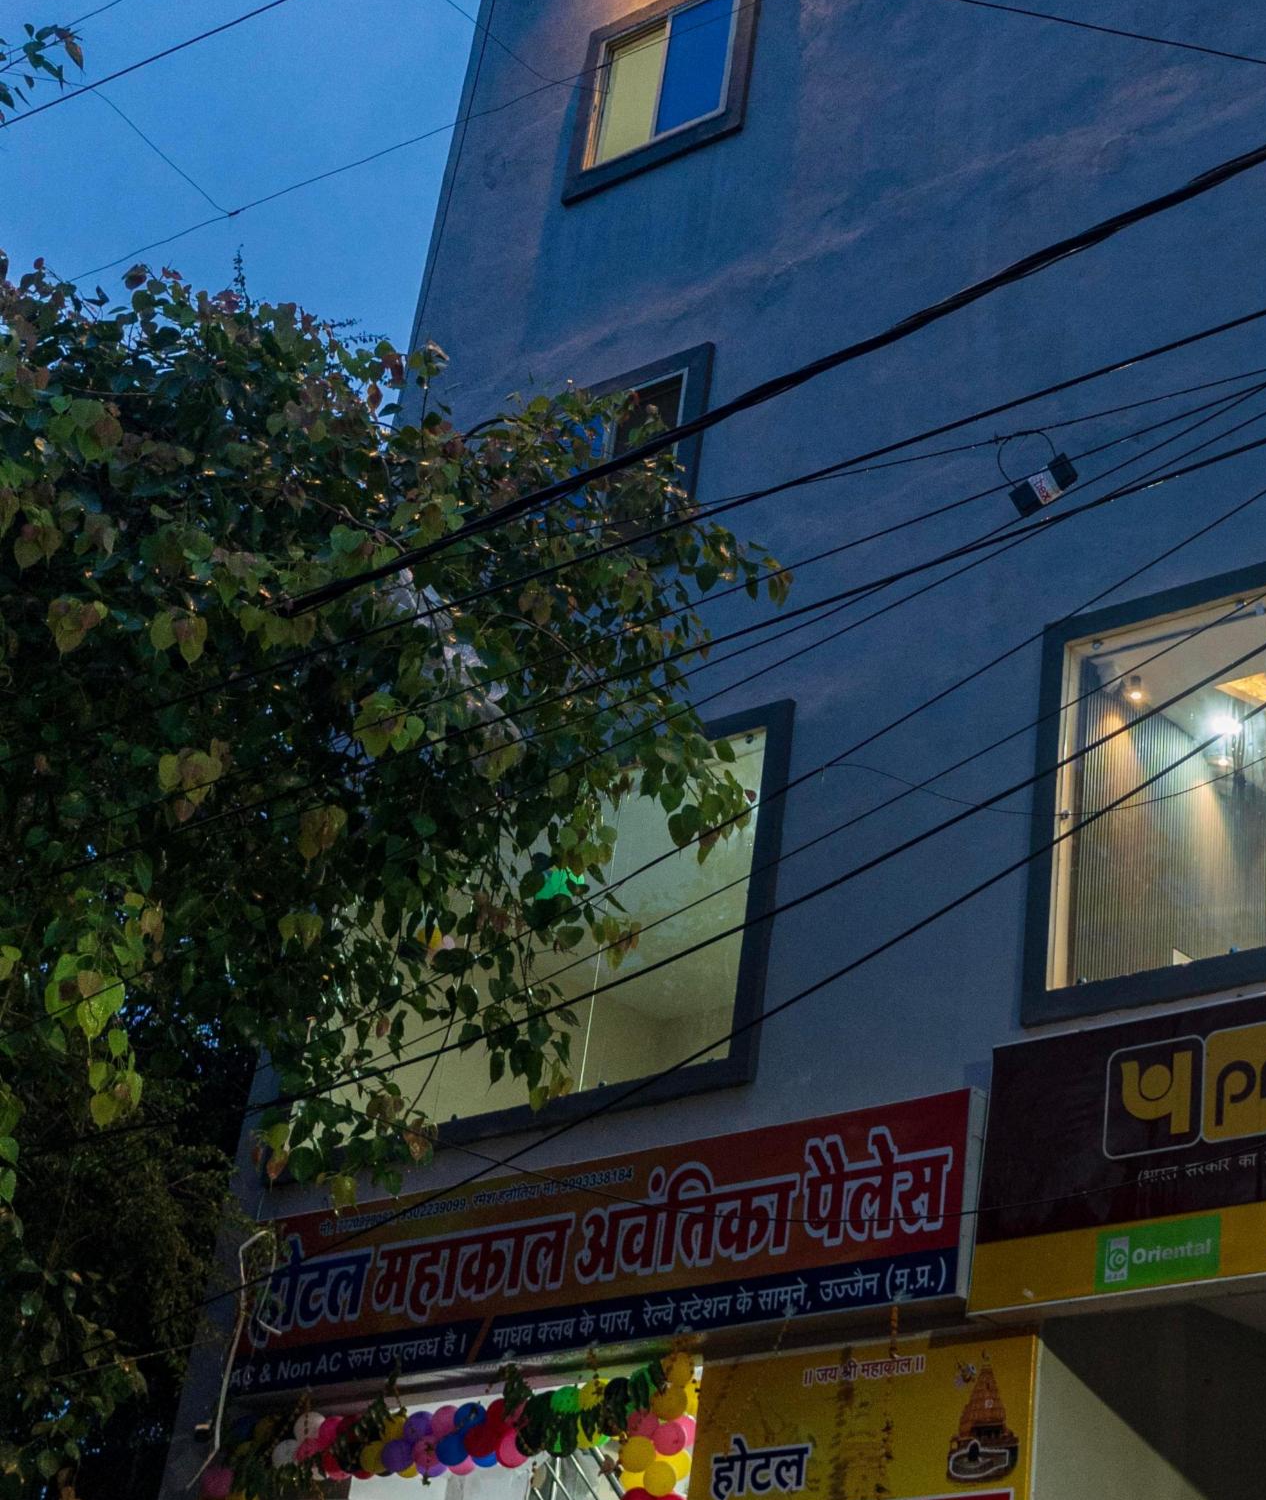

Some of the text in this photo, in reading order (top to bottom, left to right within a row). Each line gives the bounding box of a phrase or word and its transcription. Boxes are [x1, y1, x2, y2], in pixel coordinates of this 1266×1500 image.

[1238, 1153, 1258, 1168] का
[373, 1211, 577, 1323] महाकाल
[574, 1160, 800, 1285] अवंतिका
[803, 1125, 954, 1247] पैलेस
[1132, 1238, 1213, 1264] Oriental
[493, 1319, 534, 1350] माधव
[536, 1310, 576, 1342] क्लब
[575, 1303, 597, 1338] के
[680, 1288, 732, 1325] स्टेशन
[734, 1282, 758, 1314] के
[819, 1264, 879, 1301] उज्जैन
[259, 1363, 272, 1384] &
[276, 1358, 311, 1381] Non
[314, 1352, 343, 1374] AC
[816, 1366, 838, 1384] जय
[860, 1356, 913, 1378] महाकाल
